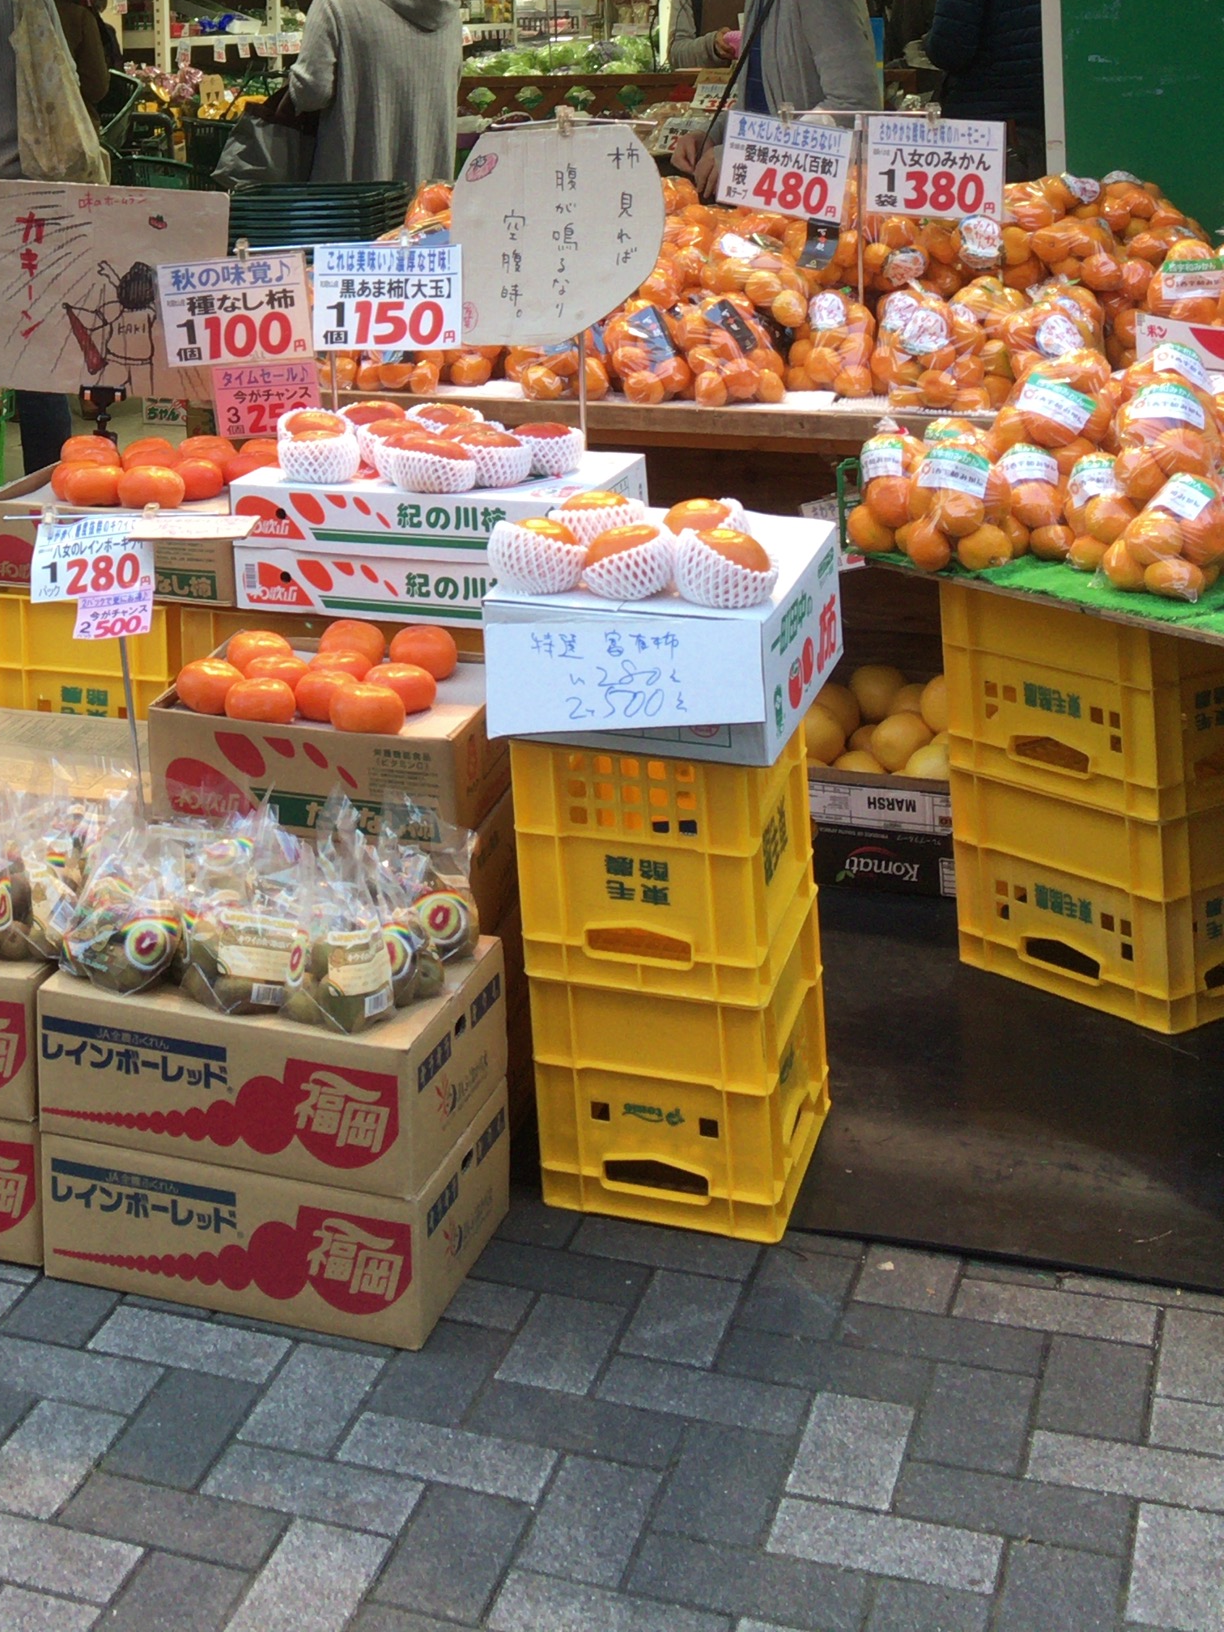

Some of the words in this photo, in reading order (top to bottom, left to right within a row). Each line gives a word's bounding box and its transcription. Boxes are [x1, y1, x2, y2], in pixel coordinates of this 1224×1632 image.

[738, 116, 842, 154] 食べだしたら止まらない!
[890, 148, 992, 172] 八女のみかん
[77, 191, 148, 214] 味のホームラン
[607, 142, 640, 266] 柿見れば
[552, 163, 578, 318] 腹が鳴るなり
[14, 210, 47, 340] カキーン
[171, 261, 274, 292] 秋の味覚
[186, 288, 296, 317] 種なし柿
[117, 322, 147, 336] KAKI
[233, 386, 312, 404] 今がチャンス
[405, 572, 498, 601] 紀の川
[90, 604, 148, 621] 今がチャンス
[867, 795, 918, 813] MARSH
[845, 855, 920, 882] Komati
[41, 1032, 228, 1090] レインボーレッド
[294, 1070, 390, 1154] 福岡
[51, 1175, 238, 1235] レインボーレッド
[307, 1218, 405, 1302] 福岡
